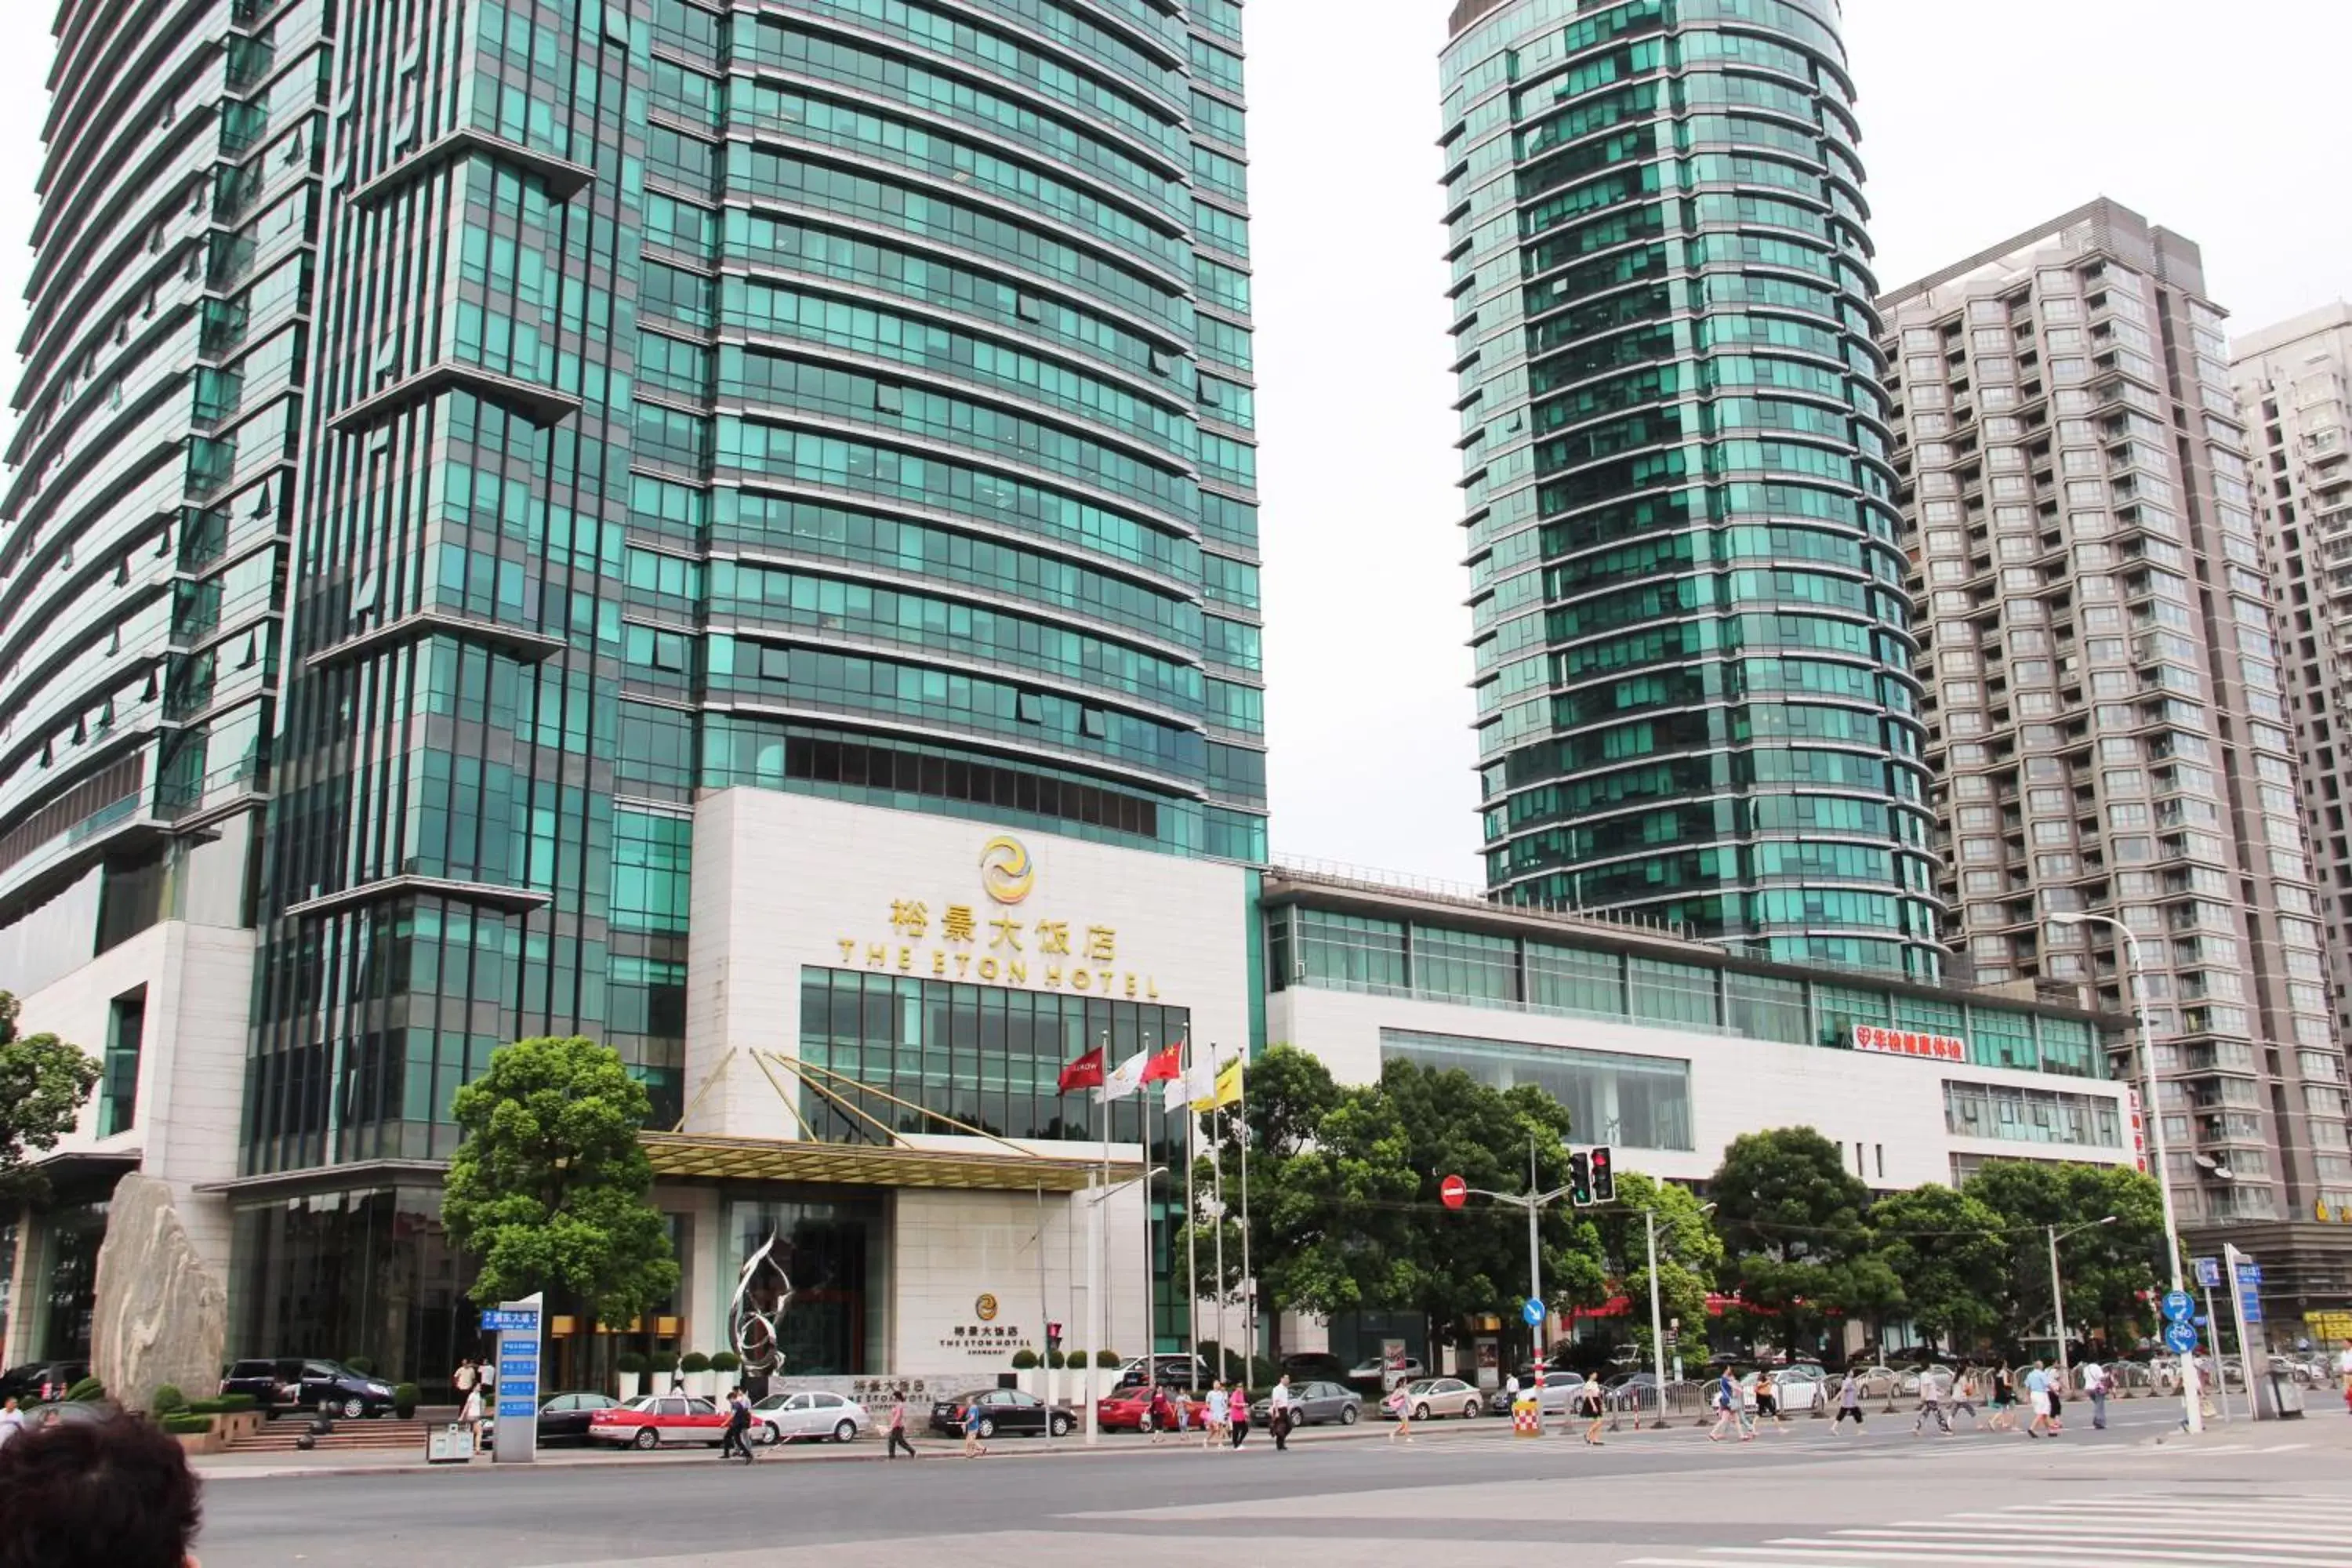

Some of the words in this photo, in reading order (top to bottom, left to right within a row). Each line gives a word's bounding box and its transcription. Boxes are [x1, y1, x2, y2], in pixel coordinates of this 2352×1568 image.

[889, 898, 1116, 961] 裕景大饭店
[838, 938, 911, 970] THE
[932, 950, 1027, 984] ETON
[1044, 965, 1159, 999] HOTEL
[954, 1326, 1018, 1337] 裕景大饭店
